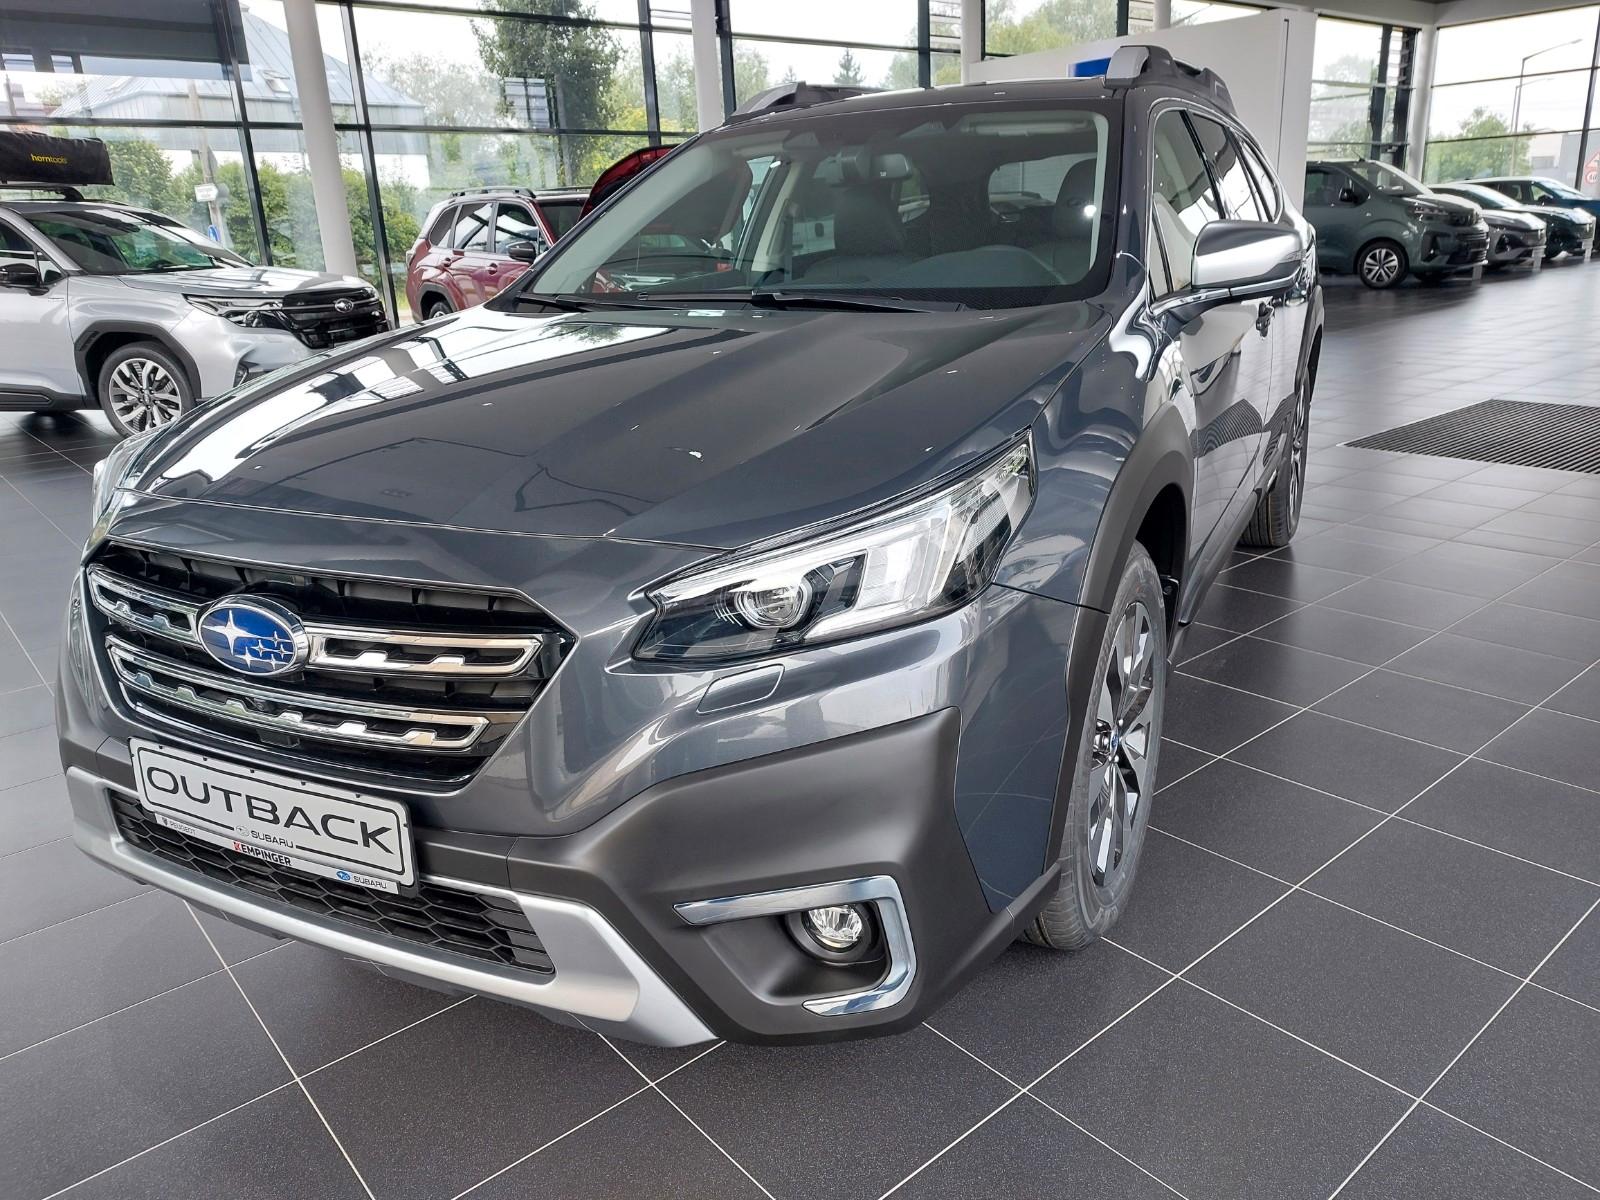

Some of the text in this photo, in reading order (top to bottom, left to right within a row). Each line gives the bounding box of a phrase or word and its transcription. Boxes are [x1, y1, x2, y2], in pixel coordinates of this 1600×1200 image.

[146, 766, 394, 855] OUTBACK
[250, 830, 294, 849] SUBARU
[233, 841, 292, 866] KEMPINGER
[353, 875, 387, 889] SUBARU
